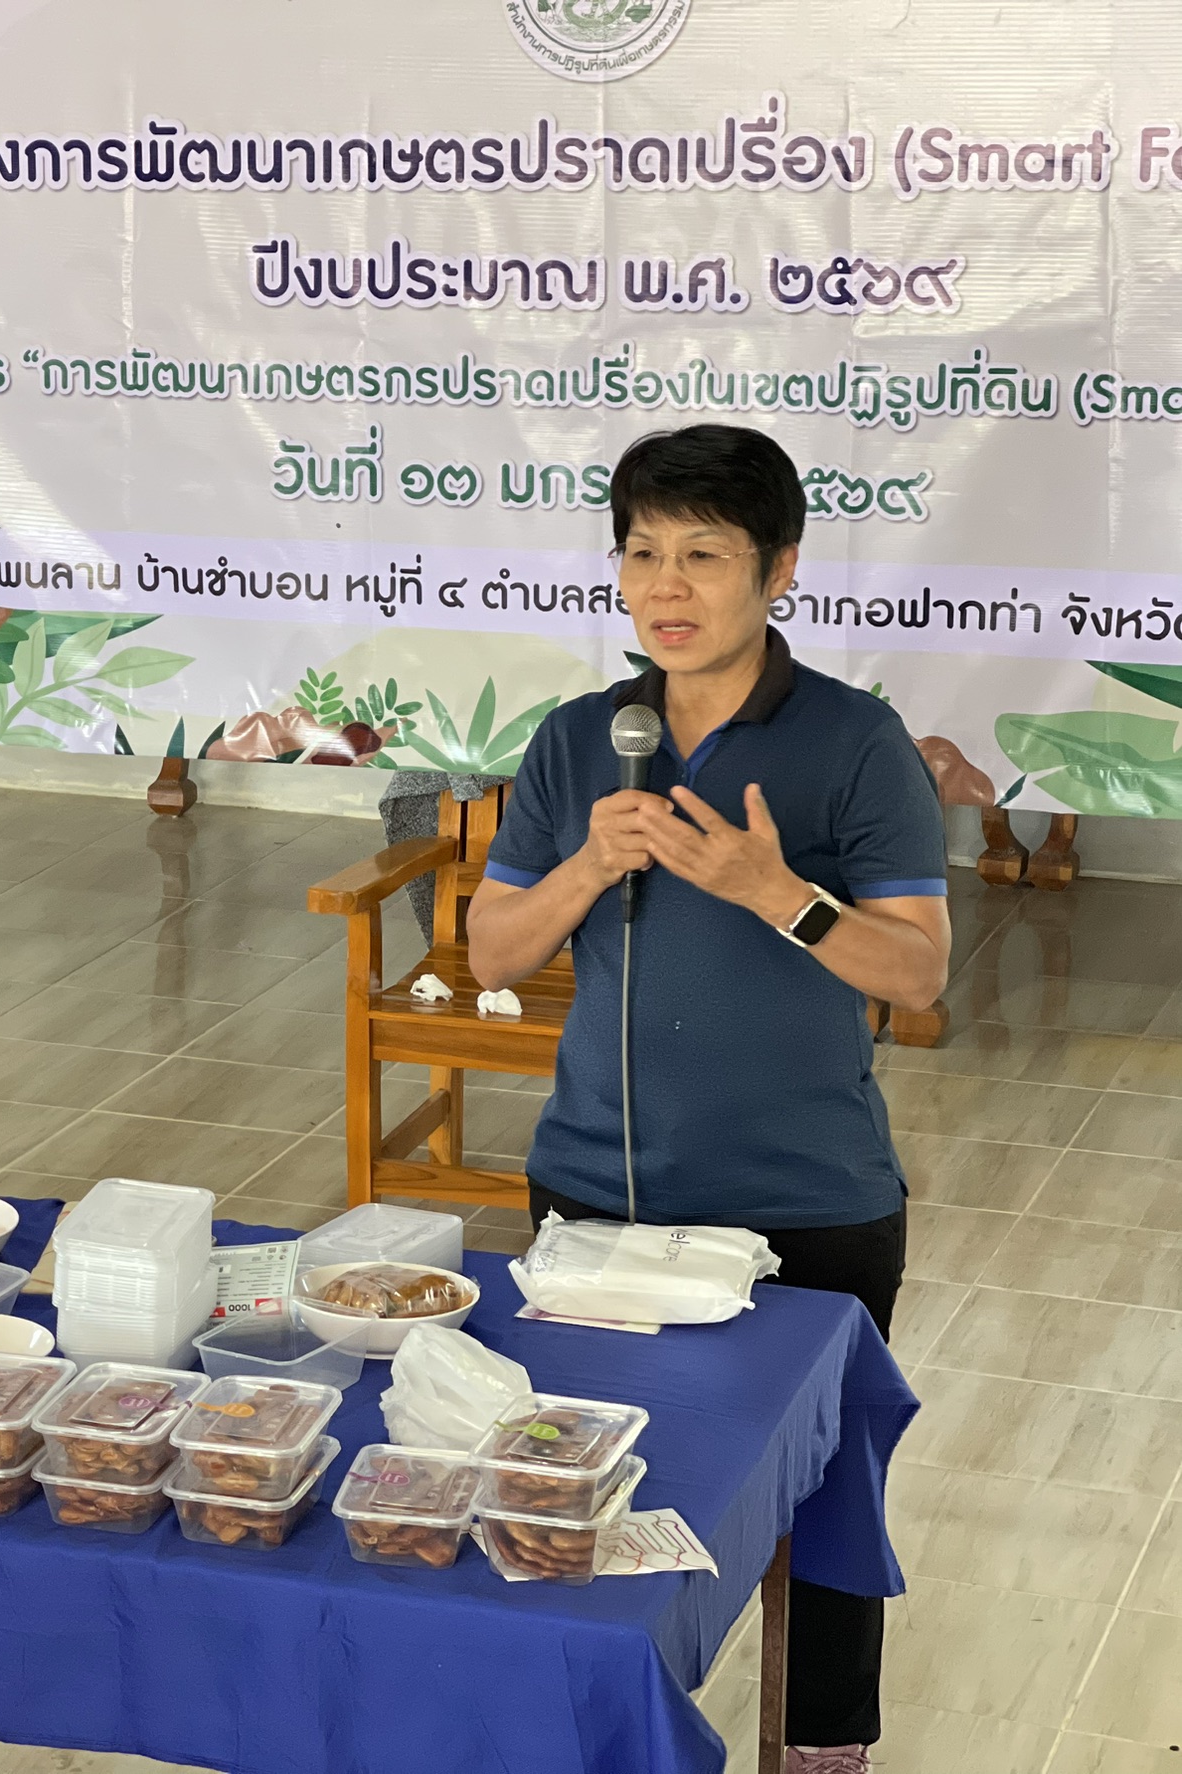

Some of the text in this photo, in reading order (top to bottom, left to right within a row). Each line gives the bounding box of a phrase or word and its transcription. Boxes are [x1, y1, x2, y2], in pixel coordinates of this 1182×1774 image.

[895, 127, 1111, 193] (Smart
[253, 240, 957, 307] ปีงบประมาณ พ.ศ. ๒๕๖๙
[273, 425, 927, 517] วันที่ ๑๓ มกร ๕๖๙
[137, 552, 328, 601] บ้านชำบอน
[346, 554, 422, 617] หมู่ที่
[439, 577, 468, 609] ๔
[768, 579, 1041, 634] อำเภอฟากท่า
